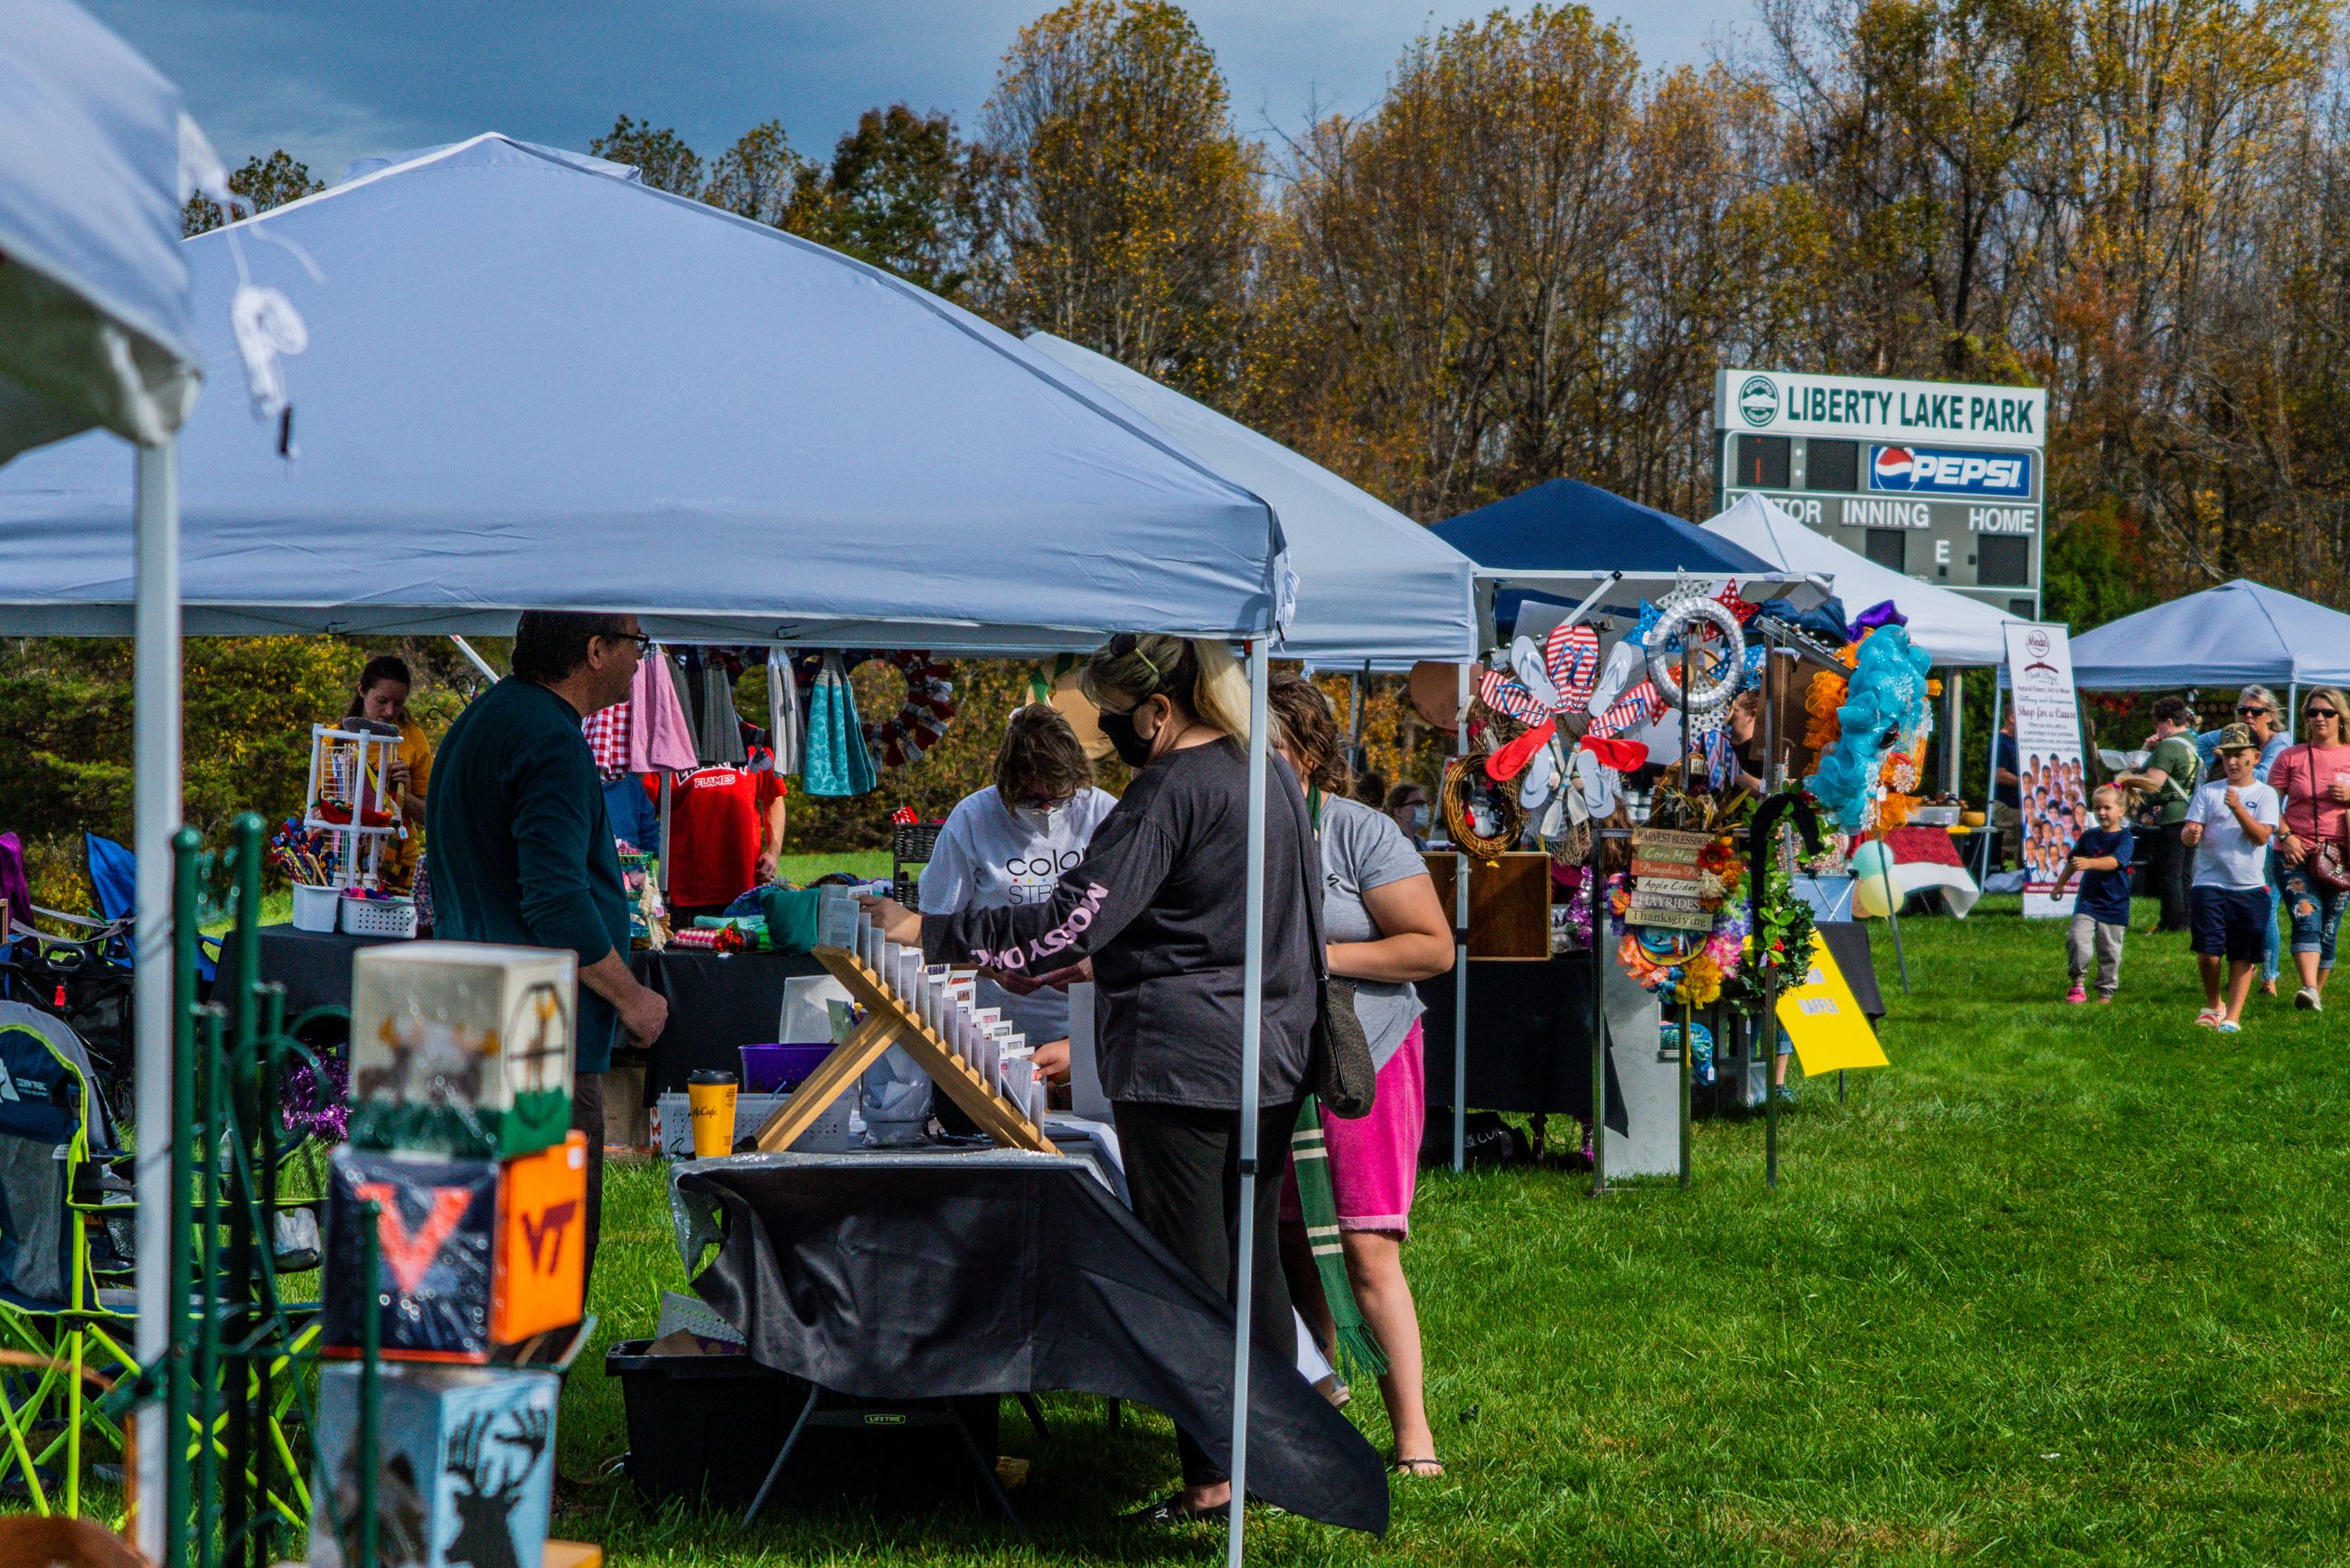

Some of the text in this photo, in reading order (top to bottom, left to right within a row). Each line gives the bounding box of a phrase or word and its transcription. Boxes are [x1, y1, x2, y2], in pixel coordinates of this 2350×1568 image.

[1745, 380, 1773, 396] BEDFORD
[1788, 386, 2035, 434] LIBERTY LAKE PARK
[1910, 455, 2020, 488] PEPSI
[1843, 499, 1931, 528] INNING
[1969, 508, 2035, 532] HOME
[1935, 540, 1950, 564] E
[2017, 705, 2035, 719] Shop
[2037, 706, 2047, 720] for
[2055, 707, 2077, 719] Cause
[694, 774, 736, 788] FLAMES
[1638, 831, 1671, 843] HARVEST
[1645, 847, 1670, 859] Corn
[1640, 861, 1681, 878] Pumpkin
[1645, 879, 1698, 891] Apple Cider
[1638, 895, 1701, 911] HAYRIDES
[1029, 881, 1109, 962] MOSSY
[1633, 910, 1706, 927] Thanksgiving
